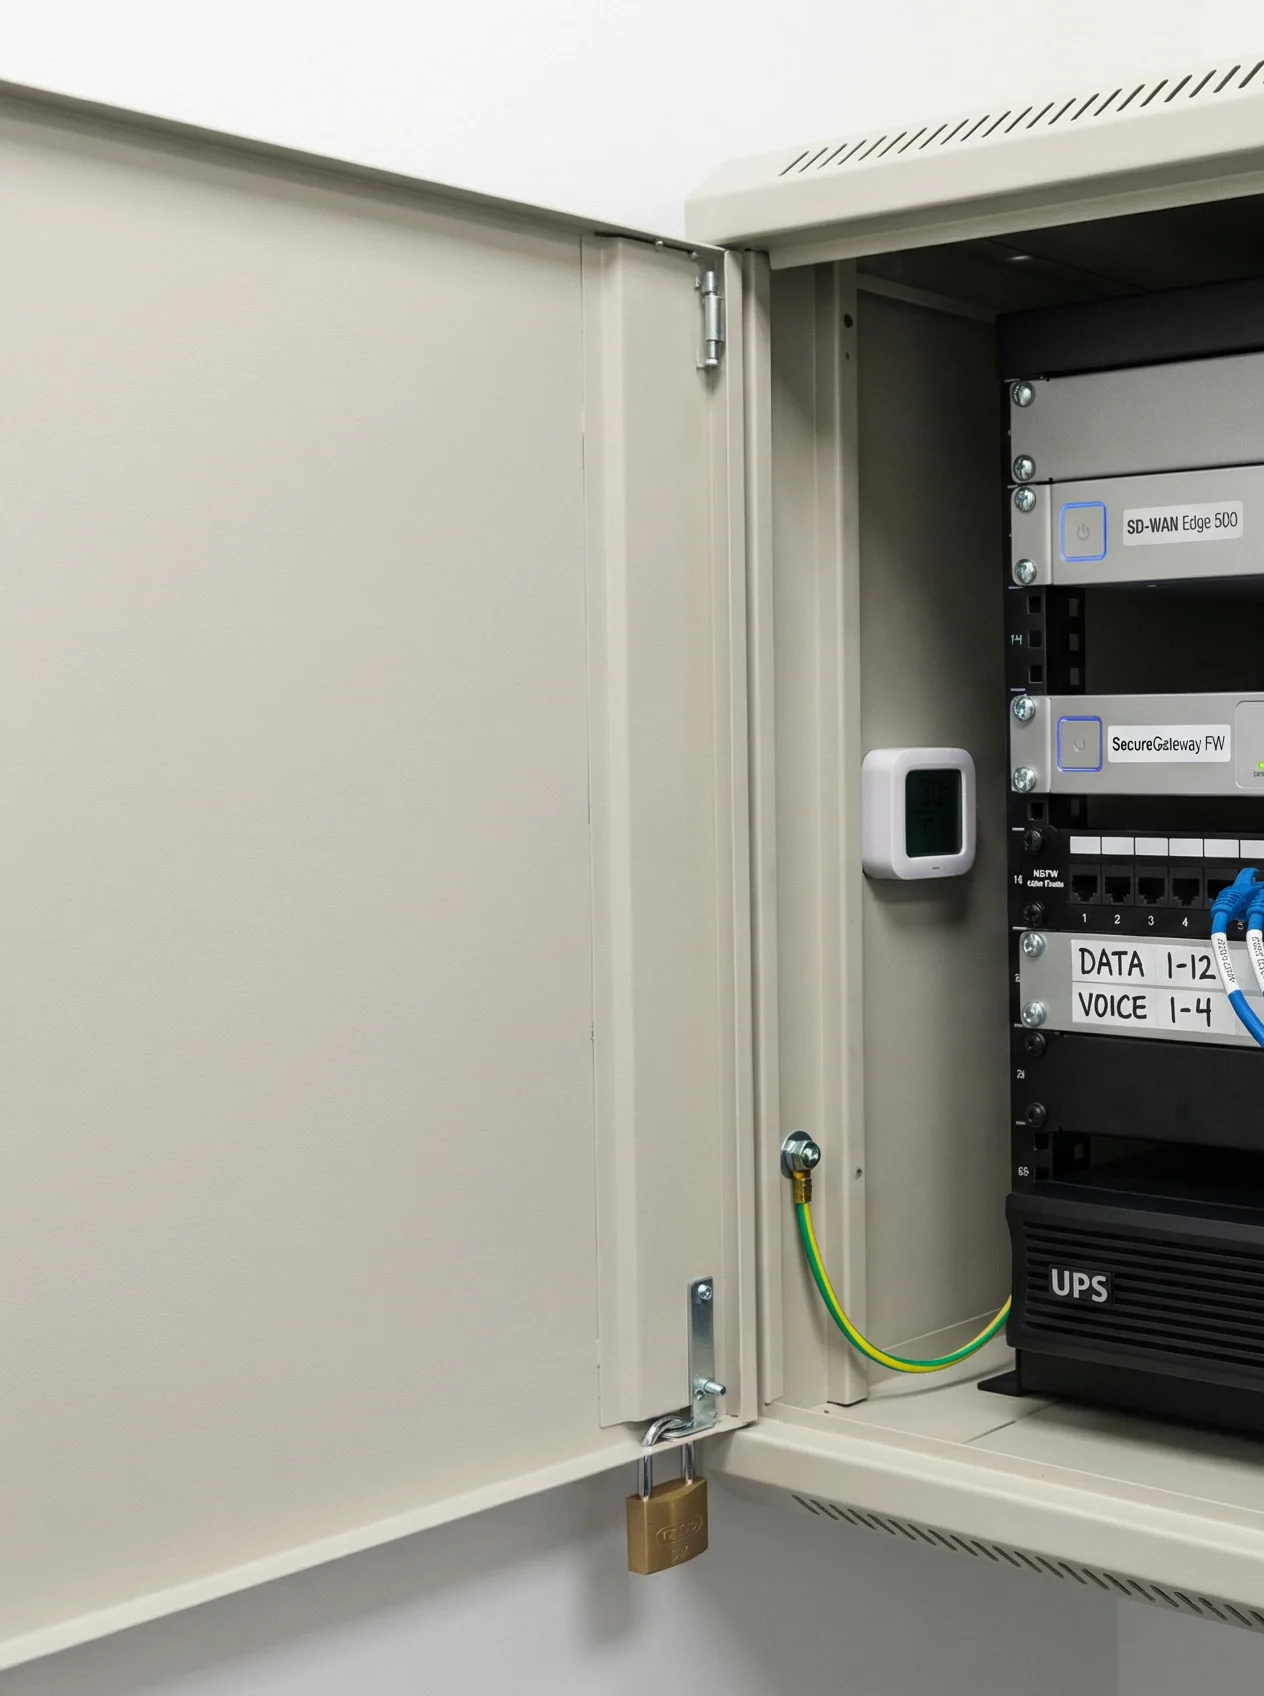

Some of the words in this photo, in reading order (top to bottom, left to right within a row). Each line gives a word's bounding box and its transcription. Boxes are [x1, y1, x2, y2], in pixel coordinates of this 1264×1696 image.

[1127, 515, 1179, 535] SD-WAN
[1182, 515, 1211, 534] Edge
[1205, 735, 1226, 751] FW
[1082, 913, 1087, 923] 1
[1114, 914, 1121, 924] 2
[1147, 915, 1155, 926] 3
[1181, 917, 1189, 927] 4
[1078, 947, 1145, 977] DATA
[1167, 951, 1217, 980] 1-12
[1078, 991, 1148, 1020] VOICE
[1170, 996, 1212, 1028] 1-4
[1051, 1268, 1109, 1303] UPS
